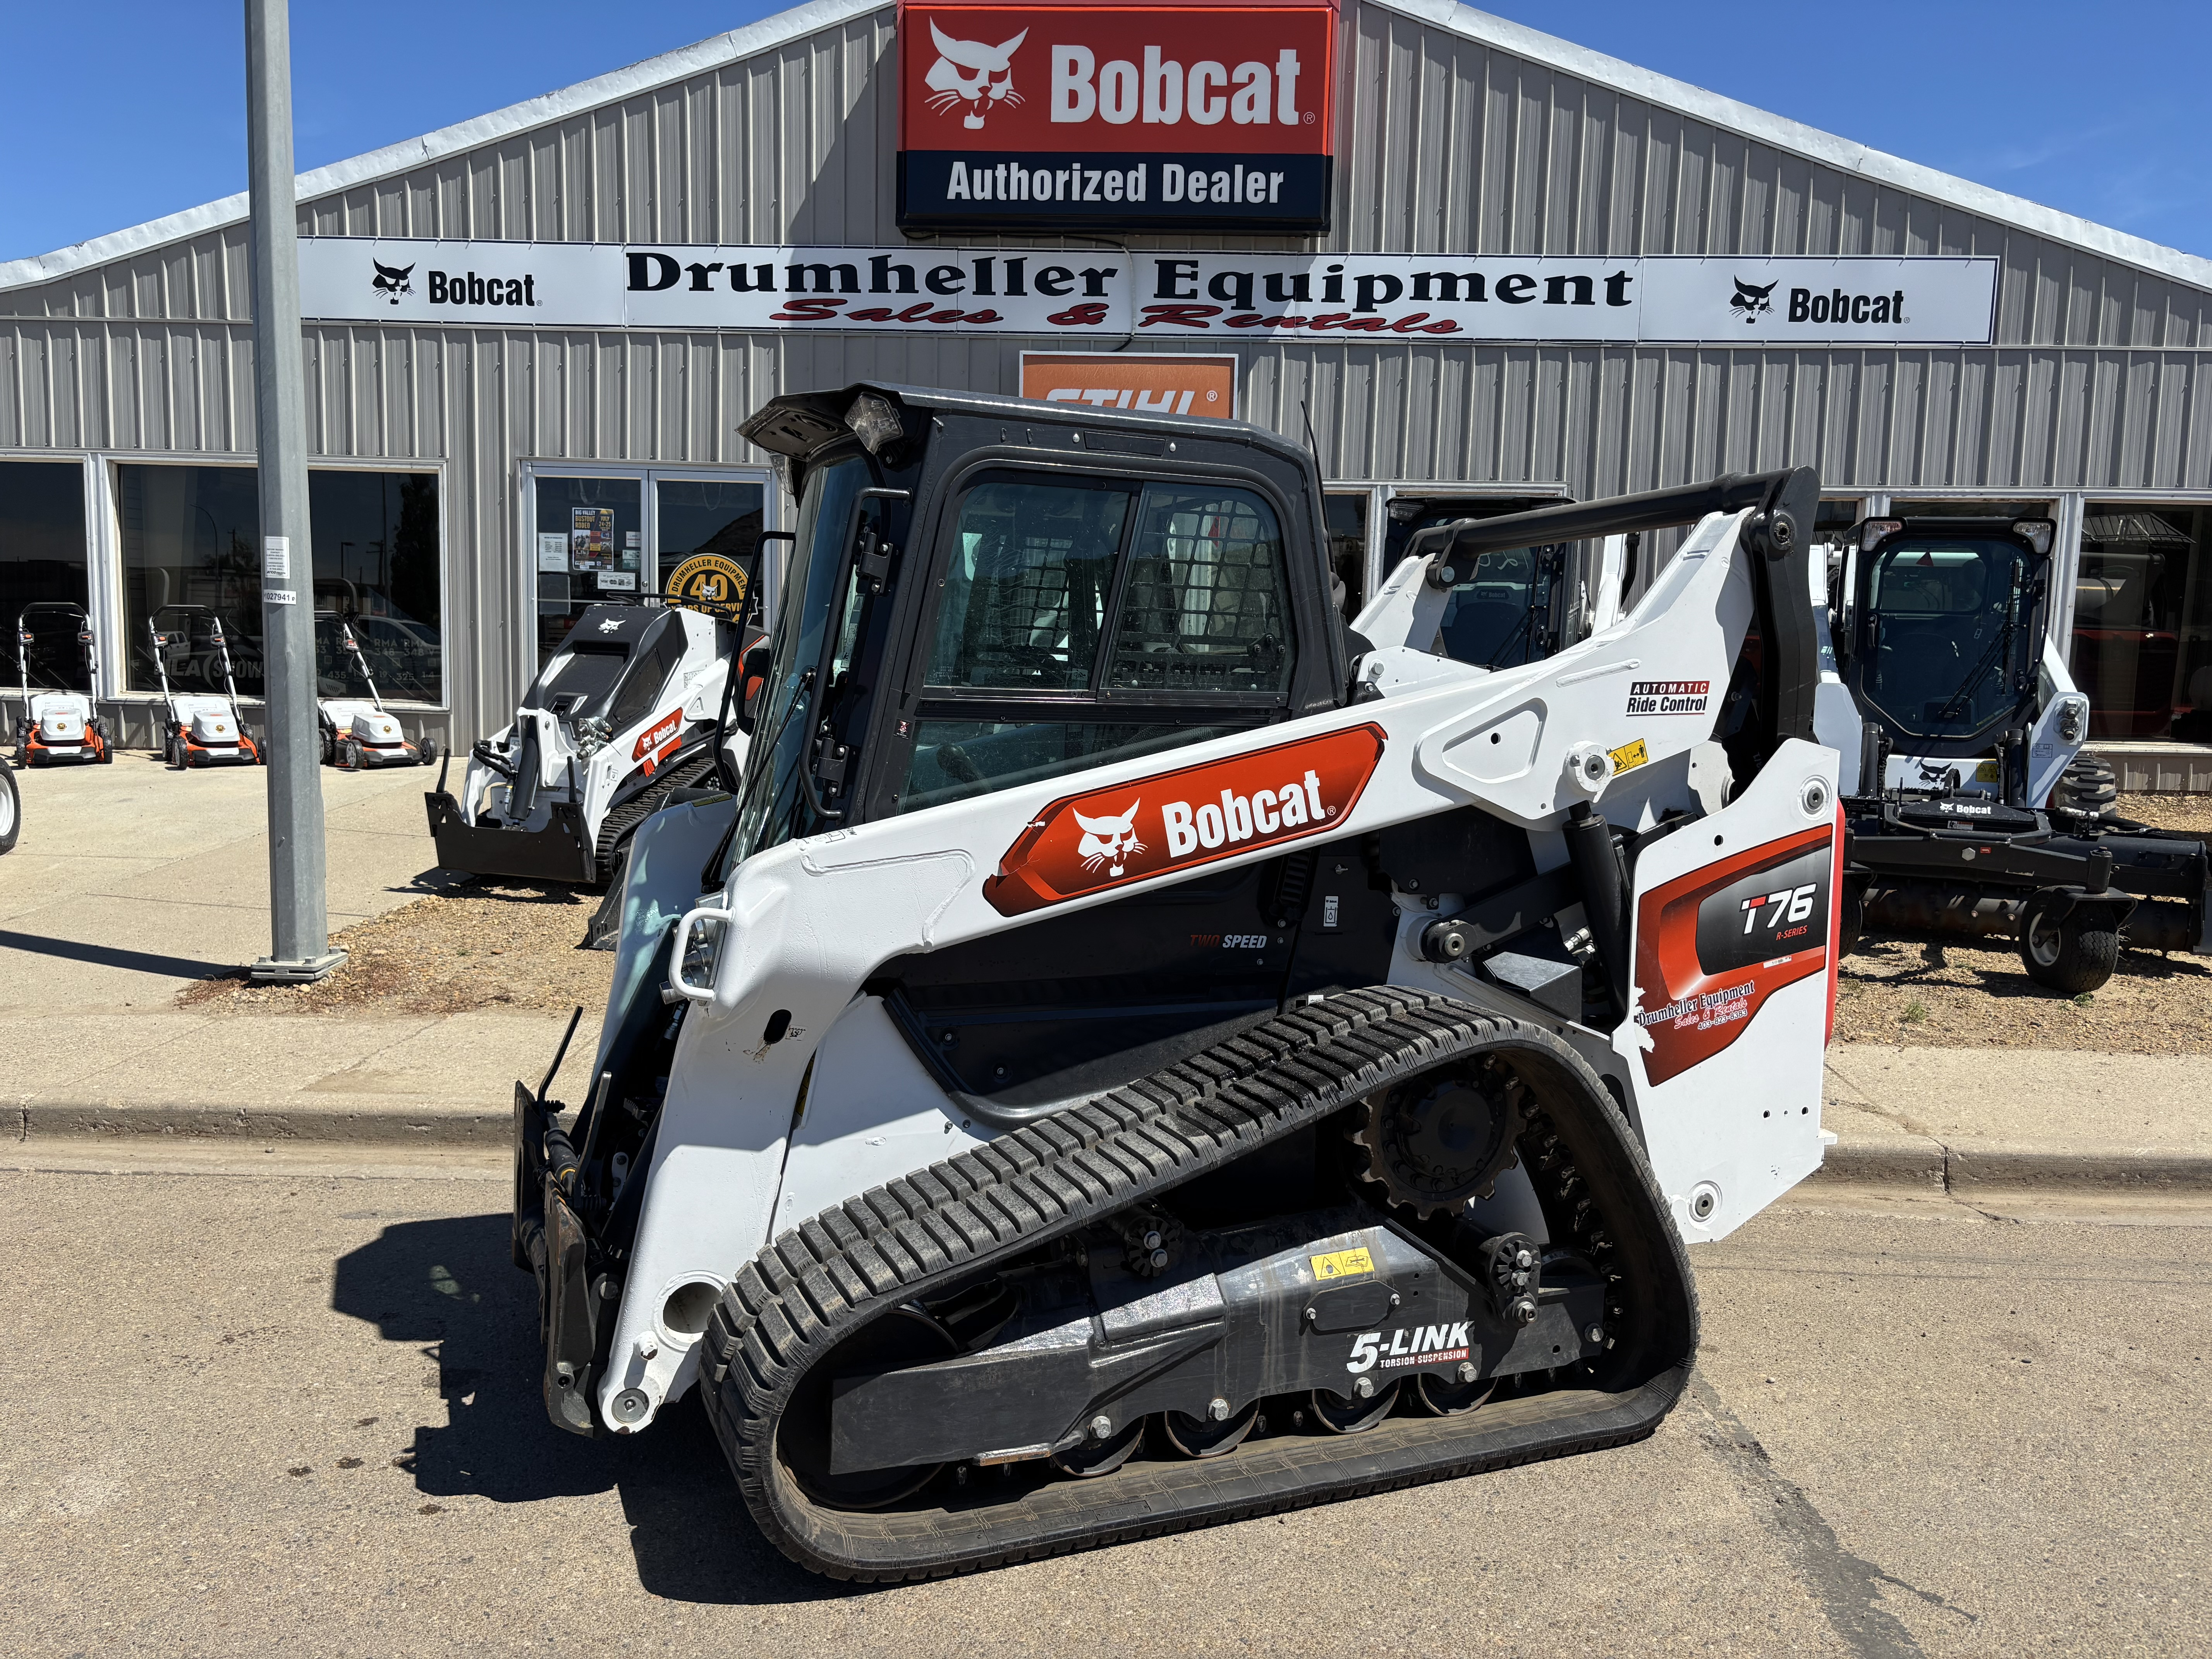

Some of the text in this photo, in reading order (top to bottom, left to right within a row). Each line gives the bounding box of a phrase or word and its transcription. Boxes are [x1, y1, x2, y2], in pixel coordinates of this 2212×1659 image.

[1050, 44, 1300, 125] Bobcat
[946, 161, 1284, 204] Authorized Dealer
[428, 270, 535, 307] Bobcat
[627, 252, 1634, 313] Drumheller Equipment
[769, 298, 1463, 335] Sales & Rentals
[1788, 288, 1904, 324] Bobcat
[672, 559, 712, 592] DRUMHELLER
[690, 574, 728, 601] 40
[316, 646, 326, 654] 53
[374, 639, 398, 647] RMA
[375, 647, 395, 656] 348
[404, 648, 424, 656] 348
[328, 670, 347, 679] 435
[396, 673, 414, 681] 325
[1633, 682, 1707, 694] AUTOMATIC
[1626, 696, 1708, 713] Ride Control
[653, 720, 677, 745] Bobcat
[1161, 769, 1326, 859] Bobcat
[1956, 804, 1991, 814] Bobcat
[1741, 883, 1817, 934] T76
[1190, 934, 1267, 948] TWO SPEED
[1776, 925, 1807, 941] R-SERIES
[1638, 980, 1755, 1026] Drumheller Equipment
[1674, 997, 1748, 1030] Sales & Rentals
[1697, 1008, 1748, 1030] 403-823-8383
[1346, 1321, 1470, 1373] 5-LINK
[1380, 1349, 1467, 1369] TORSION SUSPENSION
